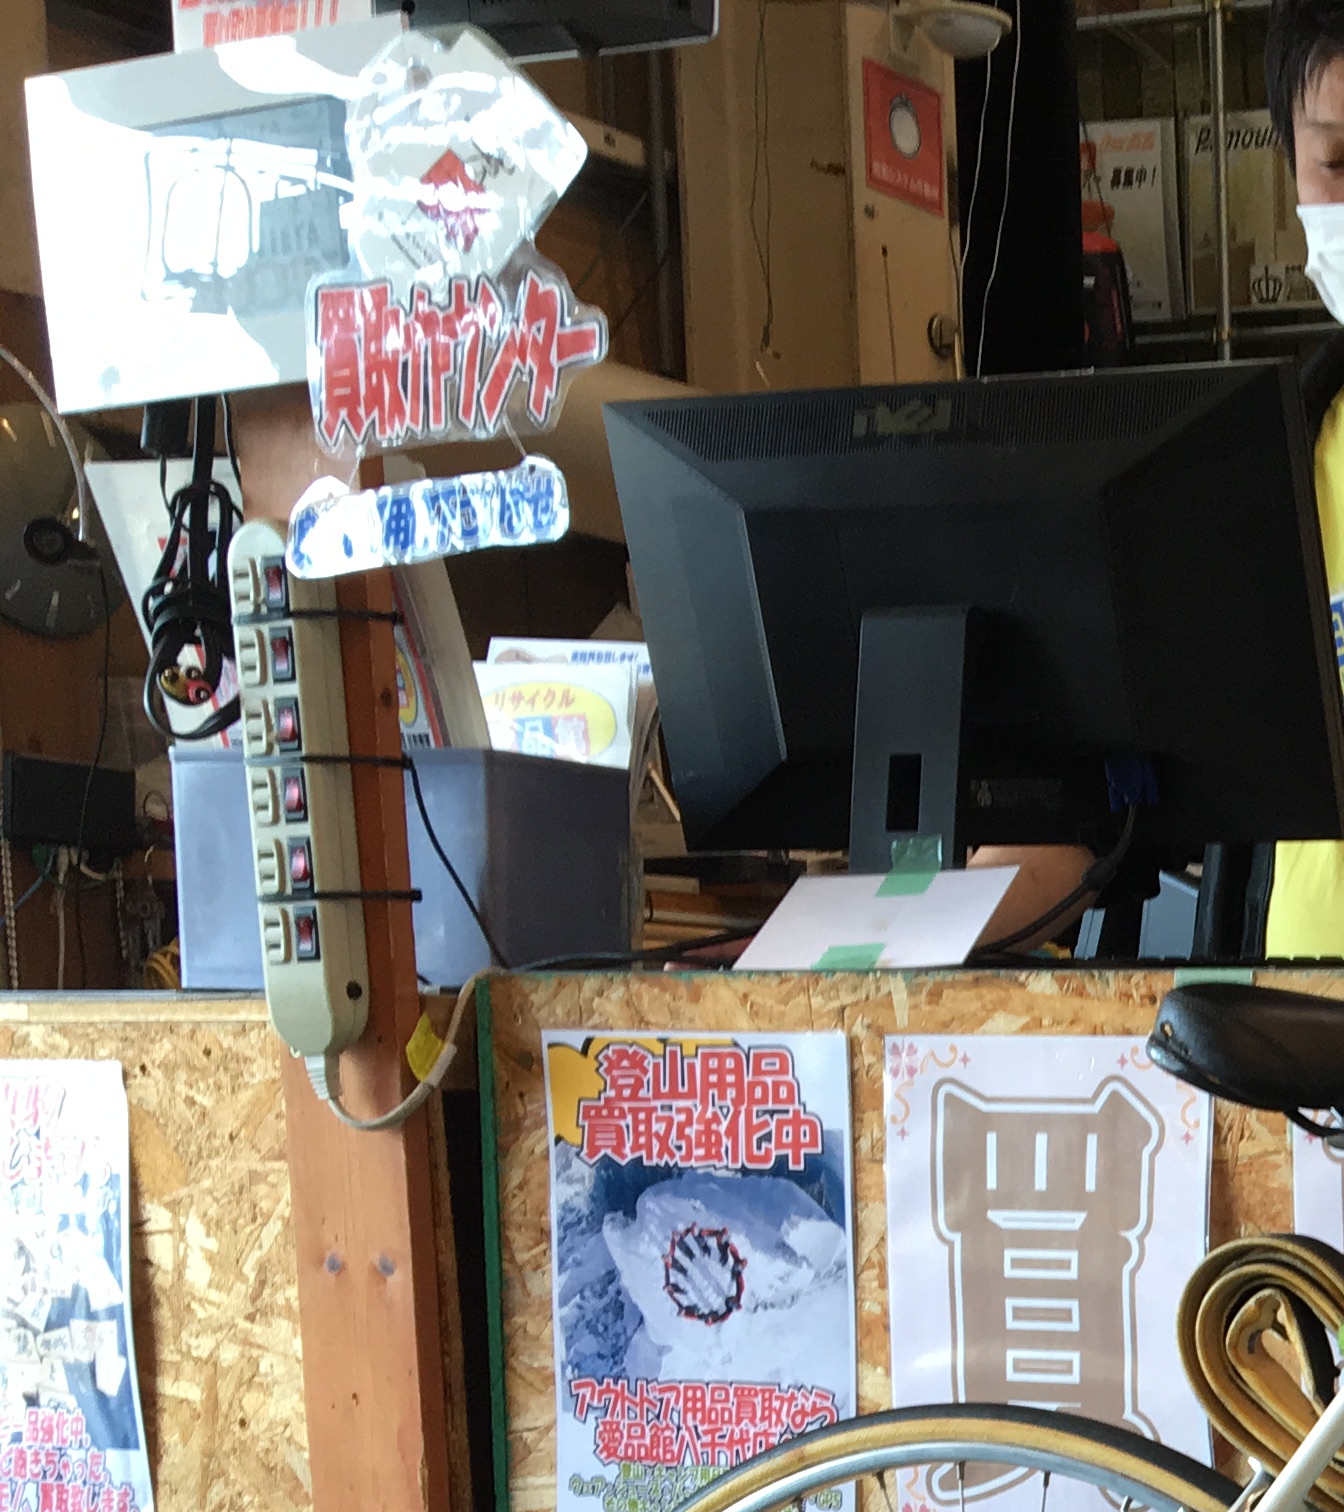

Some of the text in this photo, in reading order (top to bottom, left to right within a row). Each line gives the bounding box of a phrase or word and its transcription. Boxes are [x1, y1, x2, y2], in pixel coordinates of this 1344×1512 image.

[494, 687, 576, 712] リサイクル
[599, 1046, 797, 1108] 登山用品
[578, 1101, 823, 1170] 買取強化中
